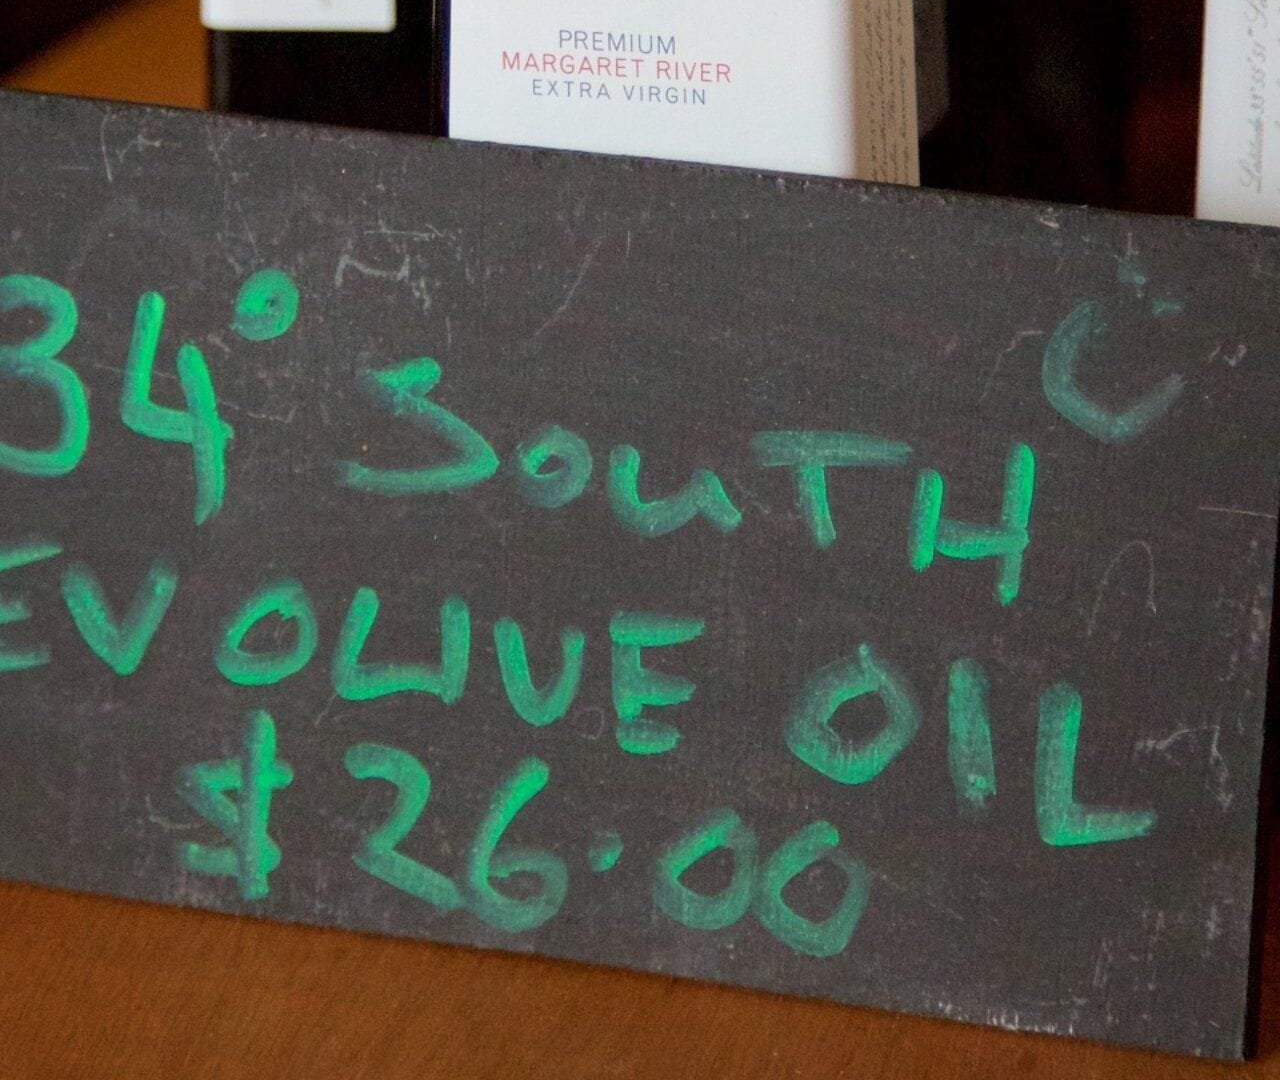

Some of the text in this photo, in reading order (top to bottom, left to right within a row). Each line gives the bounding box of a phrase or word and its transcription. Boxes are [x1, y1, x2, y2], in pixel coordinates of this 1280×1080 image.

[558, 29, 676, 56] PREMIUM
[501, 51, 731, 83] MARGARET RIVER
[532, 79, 707, 106] EXTRA VIRGIN
[215, 580, 705, 757] OLIVE
[788, 644, 1153, 848] OIL
